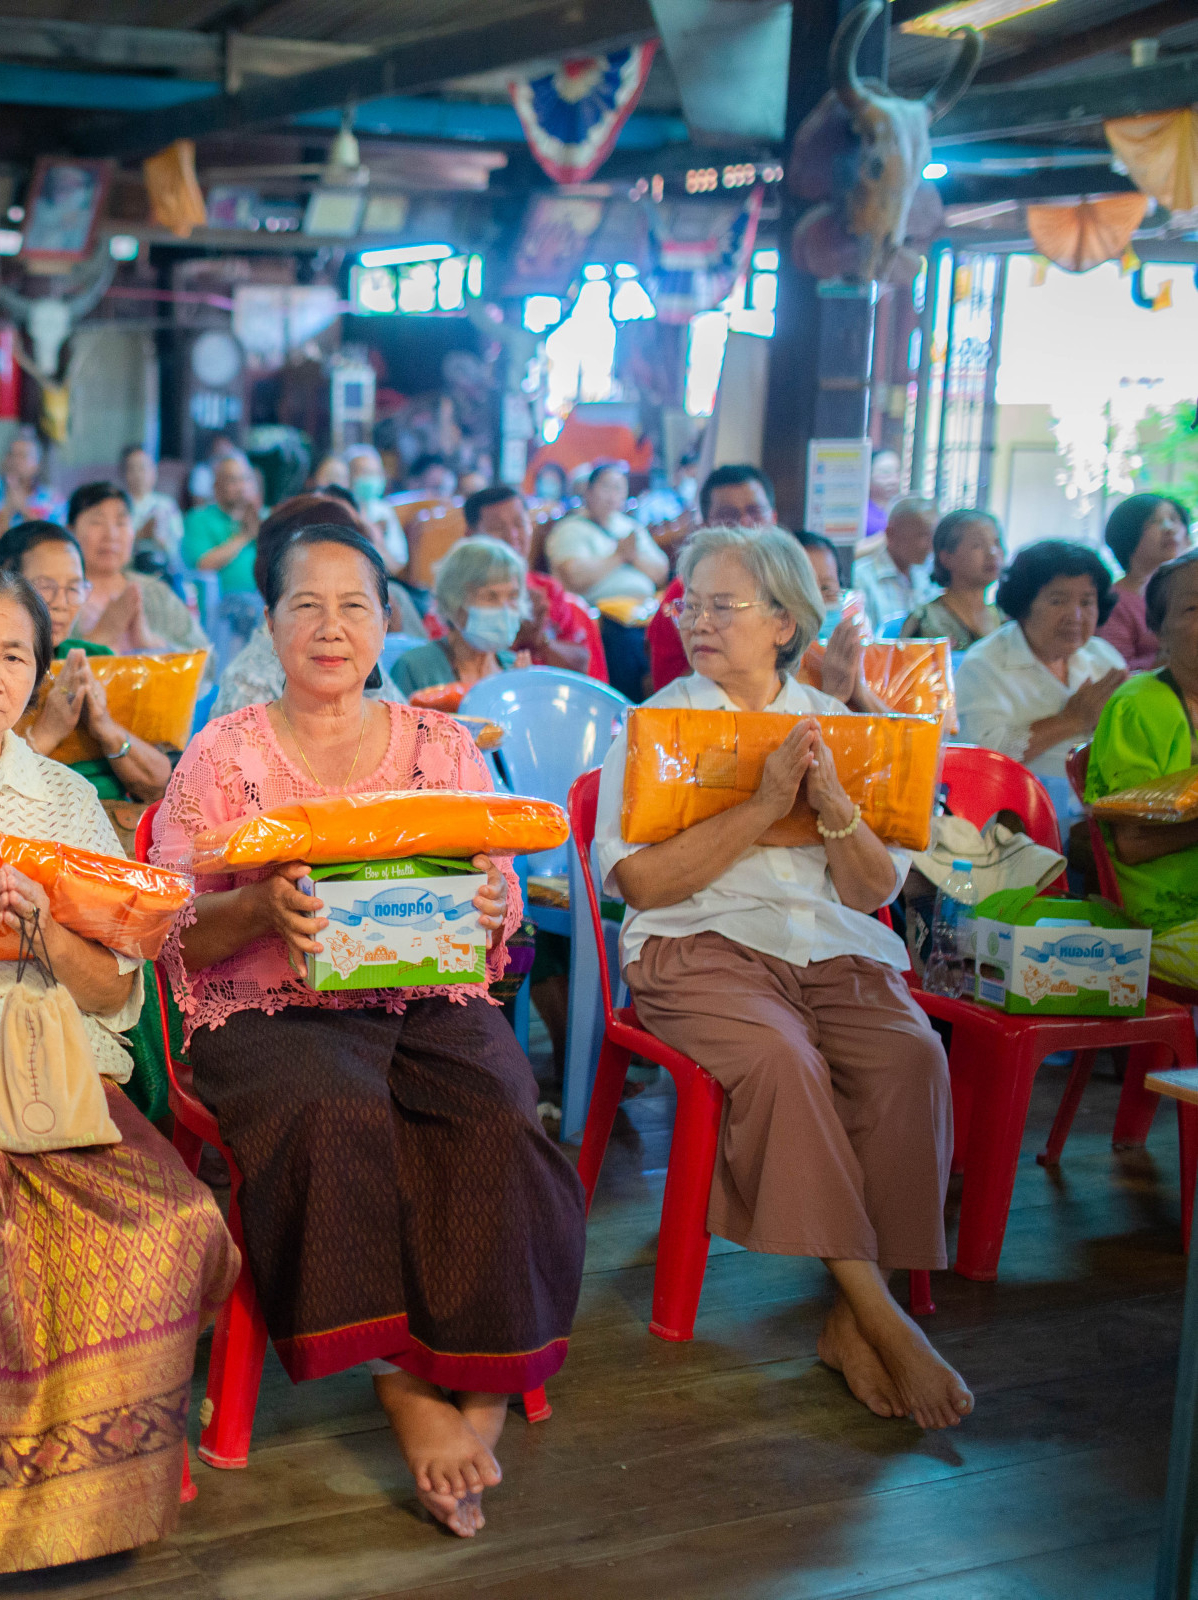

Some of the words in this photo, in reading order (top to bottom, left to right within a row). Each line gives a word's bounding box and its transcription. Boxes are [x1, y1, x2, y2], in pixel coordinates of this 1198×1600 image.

[365, 867, 379, 879] Box
[381, 867, 389, 879] of
[391, 864, 415, 877] Health
[374, 892, 433, 917] nongpho
